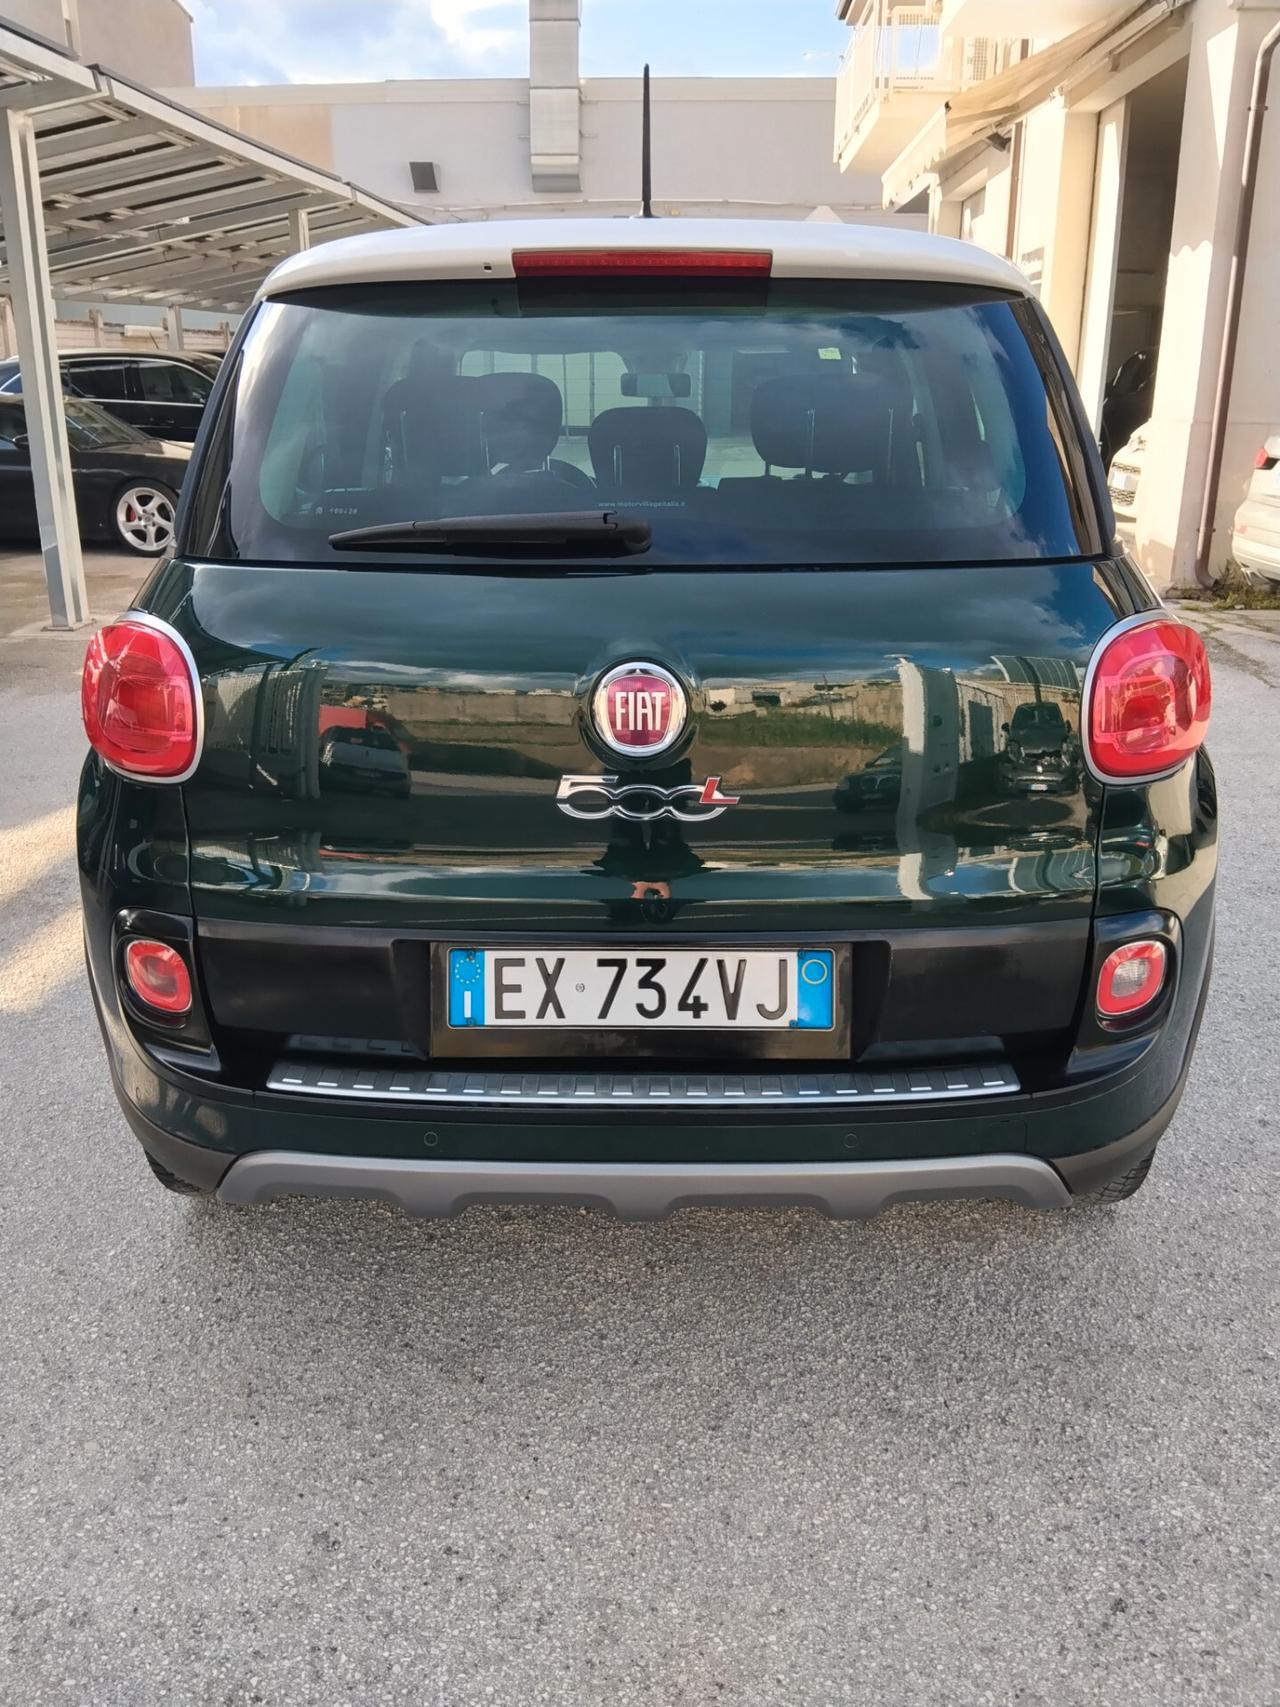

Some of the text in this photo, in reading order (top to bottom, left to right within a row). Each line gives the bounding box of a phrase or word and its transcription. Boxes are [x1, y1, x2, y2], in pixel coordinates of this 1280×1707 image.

[615, 691, 666, 731] FIAT
[556, 774, 741, 822] 500L
[494, 957, 788, 1021] EX 734VJ
